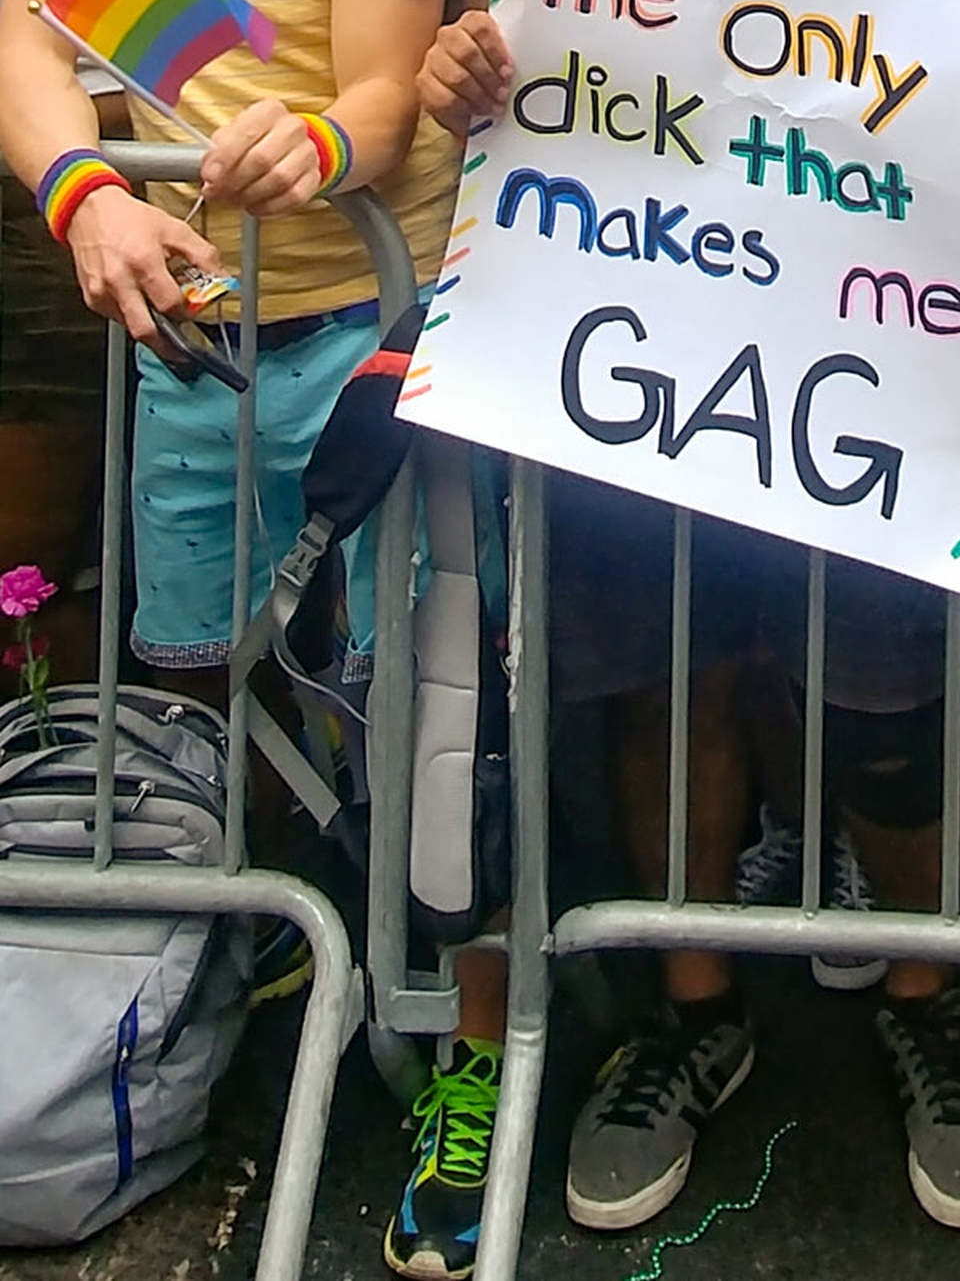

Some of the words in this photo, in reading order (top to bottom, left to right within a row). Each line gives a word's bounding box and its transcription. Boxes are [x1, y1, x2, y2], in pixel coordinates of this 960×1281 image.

[508, 50, 707, 166] dick
[728, 115, 915, 221] that
[720, 1, 928, 135] only
[496, 168, 781, 287] makes
[560, 305, 906, 520] GAG
